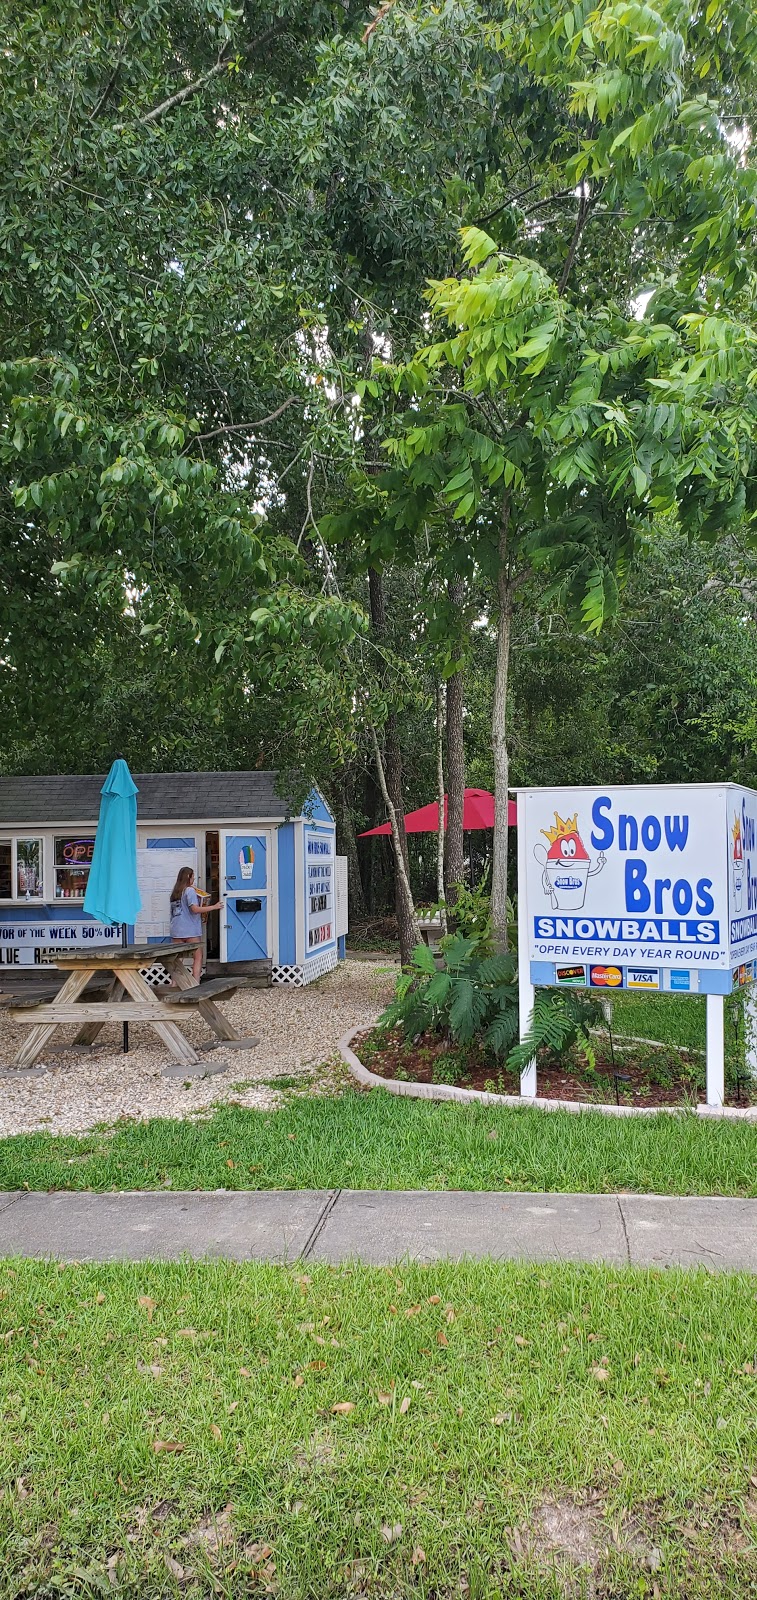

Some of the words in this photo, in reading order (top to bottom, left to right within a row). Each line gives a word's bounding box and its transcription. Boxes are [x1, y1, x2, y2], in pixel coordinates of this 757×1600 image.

[590, 796, 689, 852] Snow
[624, 858, 715, 917] Bros
[17, 928, 28, 938] OF
[49, 927, 77, 939] WEEK
[82, 927, 103, 938] 50%
[104, 927, 122, 938] OFF
[537, 918, 716, 942] SNOWBALLS
[534, 944, 570, 955] "OPEN
[572, 946, 611, 957] EVERY
[612, 948, 637, 958] DAY
[639, 949, 671, 960] YEAR
[675, 951, 726, 961] ROUND"
[591, 972, 622, 980] MasterCard
[632, 974, 653, 983] VISA
